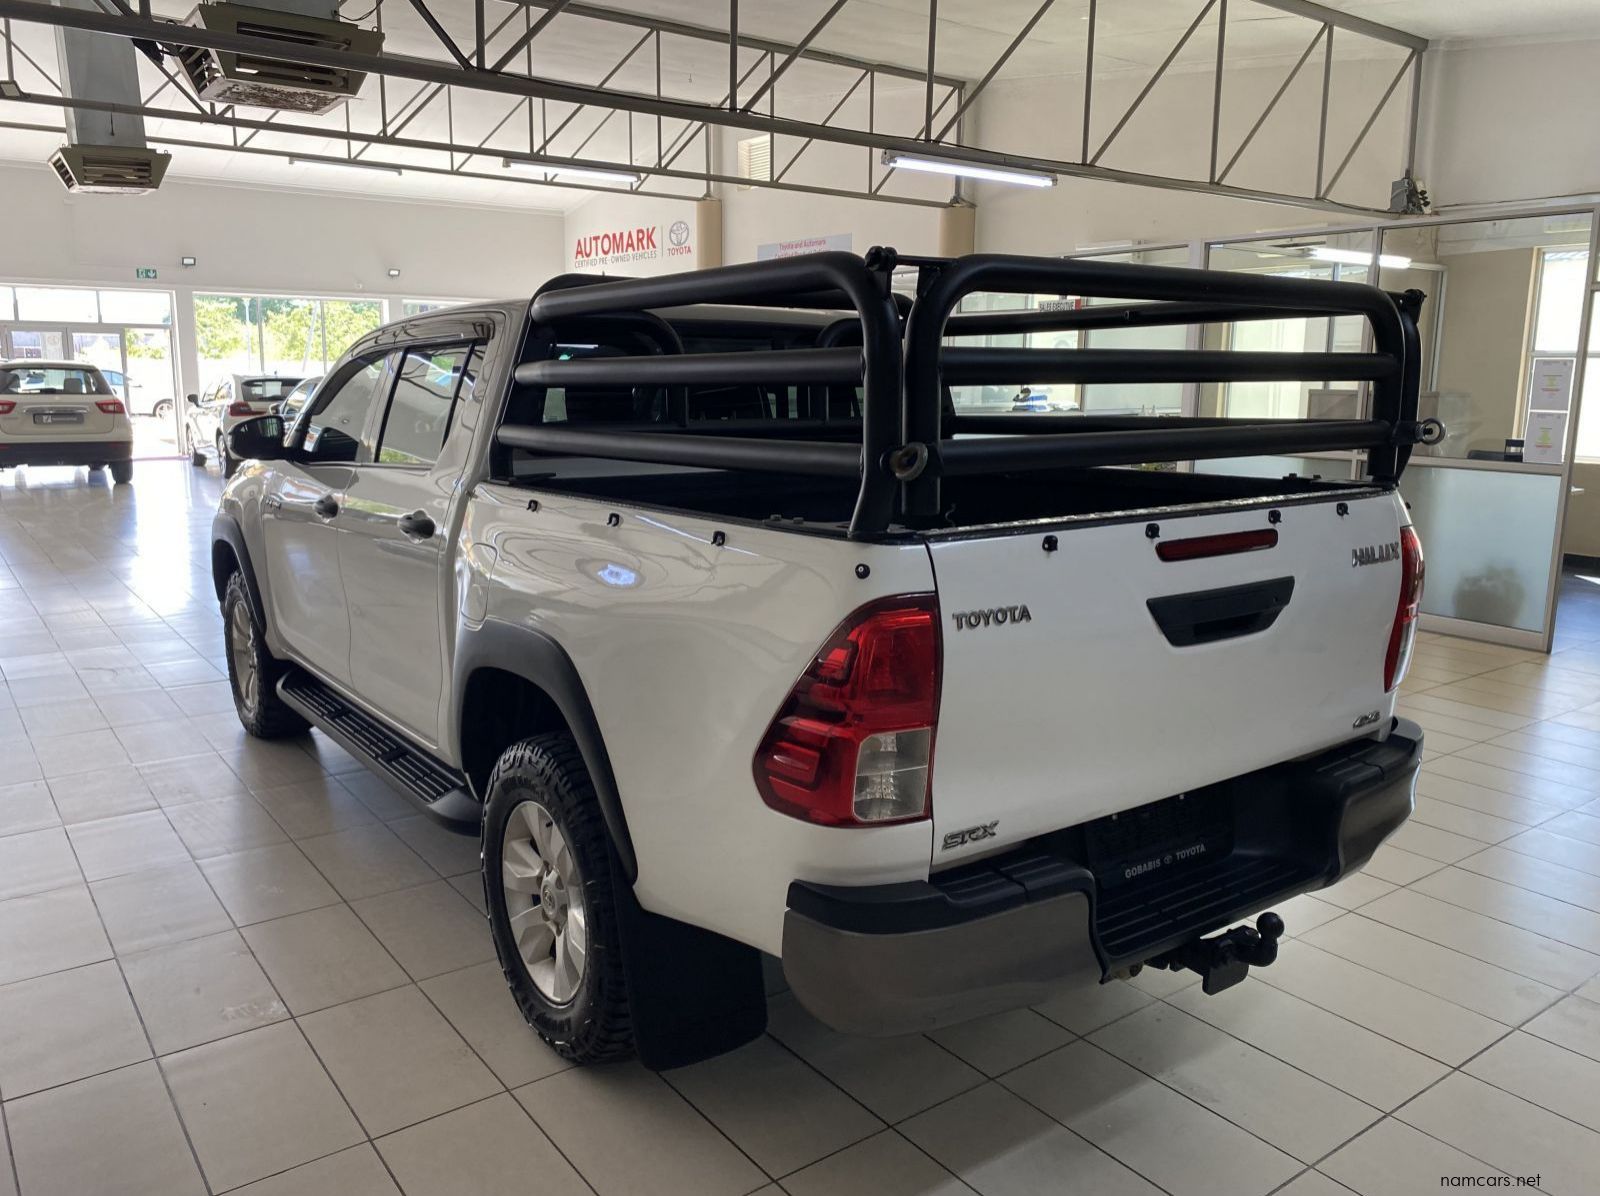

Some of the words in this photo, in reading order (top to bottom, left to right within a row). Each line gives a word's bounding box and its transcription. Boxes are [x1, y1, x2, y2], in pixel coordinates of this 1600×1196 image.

[575, 226, 657, 260] AUTOMARK
[667, 246, 692, 257] TOYOTA
[574, 258, 598, 269] CERTIFIED
[610, 253, 631, 264] OWNED
[631, 250, 657, 262] VEHICLES
[1351, 541, 1400, 568] HILUX
[952, 604, 1032, 631] TOYOTA
[942, 820, 999, 851] SRX
[1124, 859, 1161, 879] GOBABIS
[1175, 843, 1207, 861] TOYOTA
